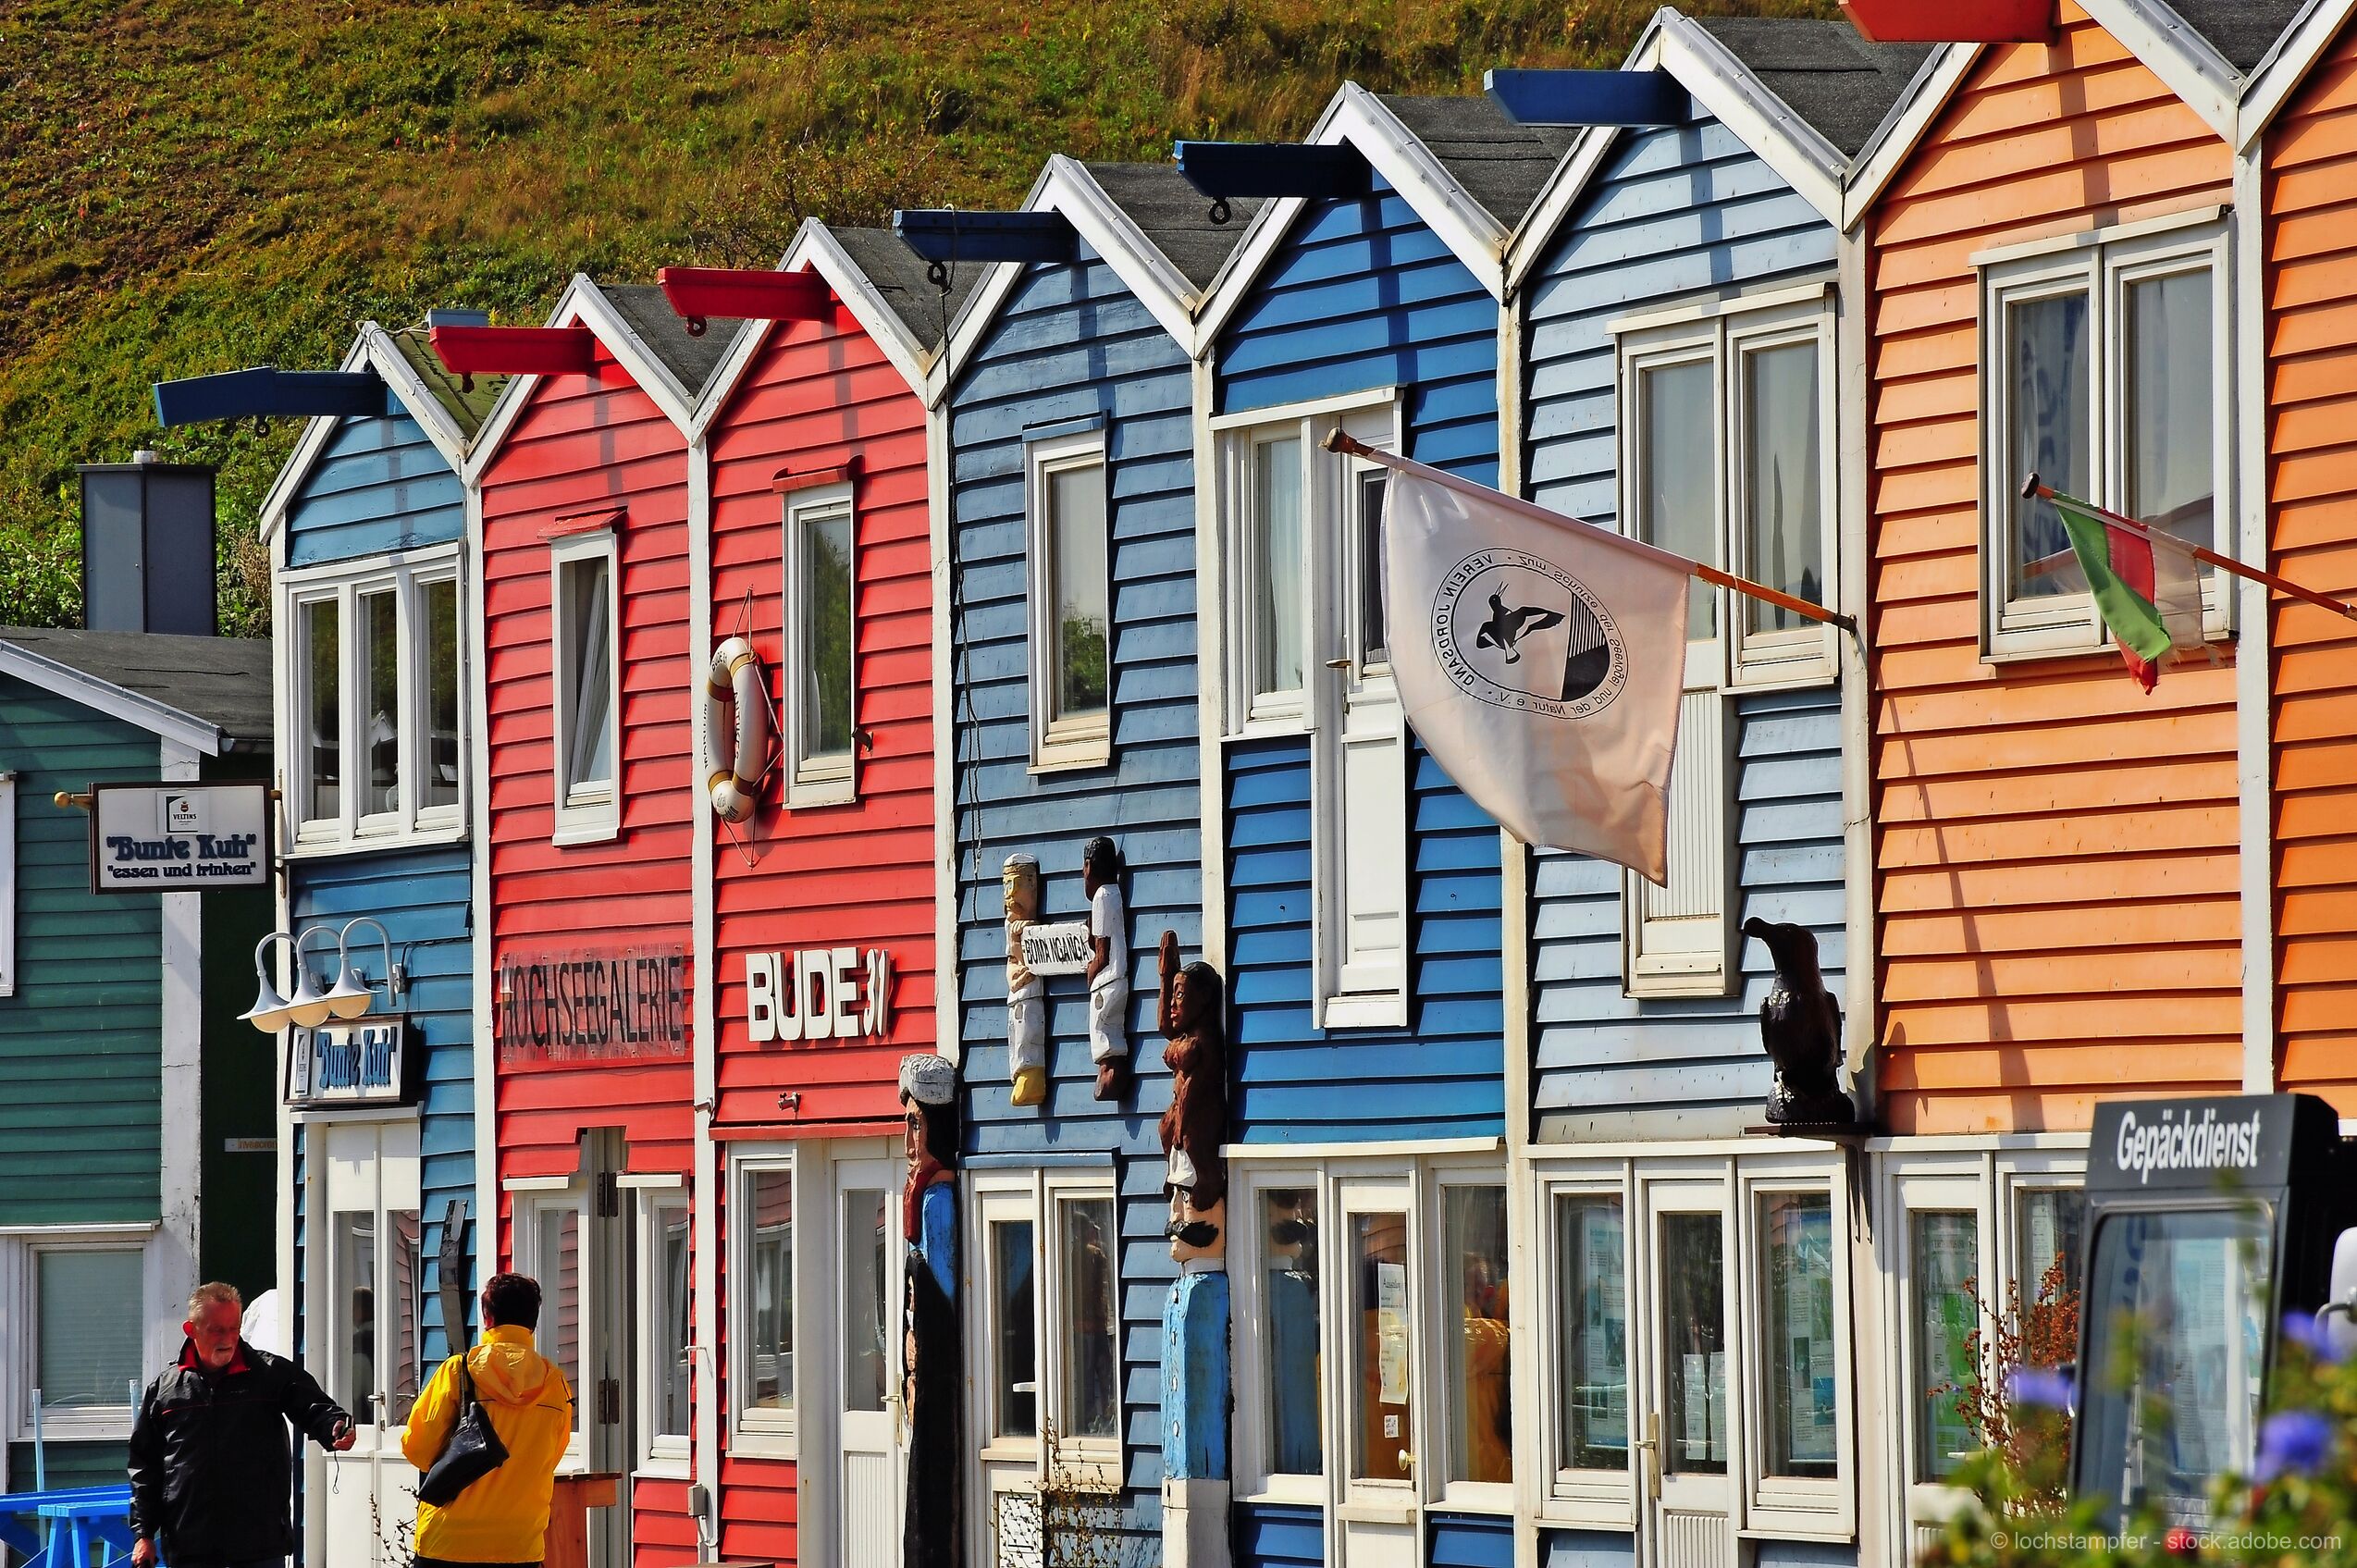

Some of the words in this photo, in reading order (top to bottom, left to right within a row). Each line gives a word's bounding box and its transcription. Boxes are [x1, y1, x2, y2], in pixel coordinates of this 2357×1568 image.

[107, 864, 159, 879] "essen
[163, 863, 192, 878] und
[196, 861, 256, 877] trinken"
[502, 956, 683, 1048] HOCHSEEGALERIE
[746, 947, 861, 1042] BUDE
[863, 948, 889, 1037] 31
[2116, 1108, 2261, 1185] Gepäckdienst
